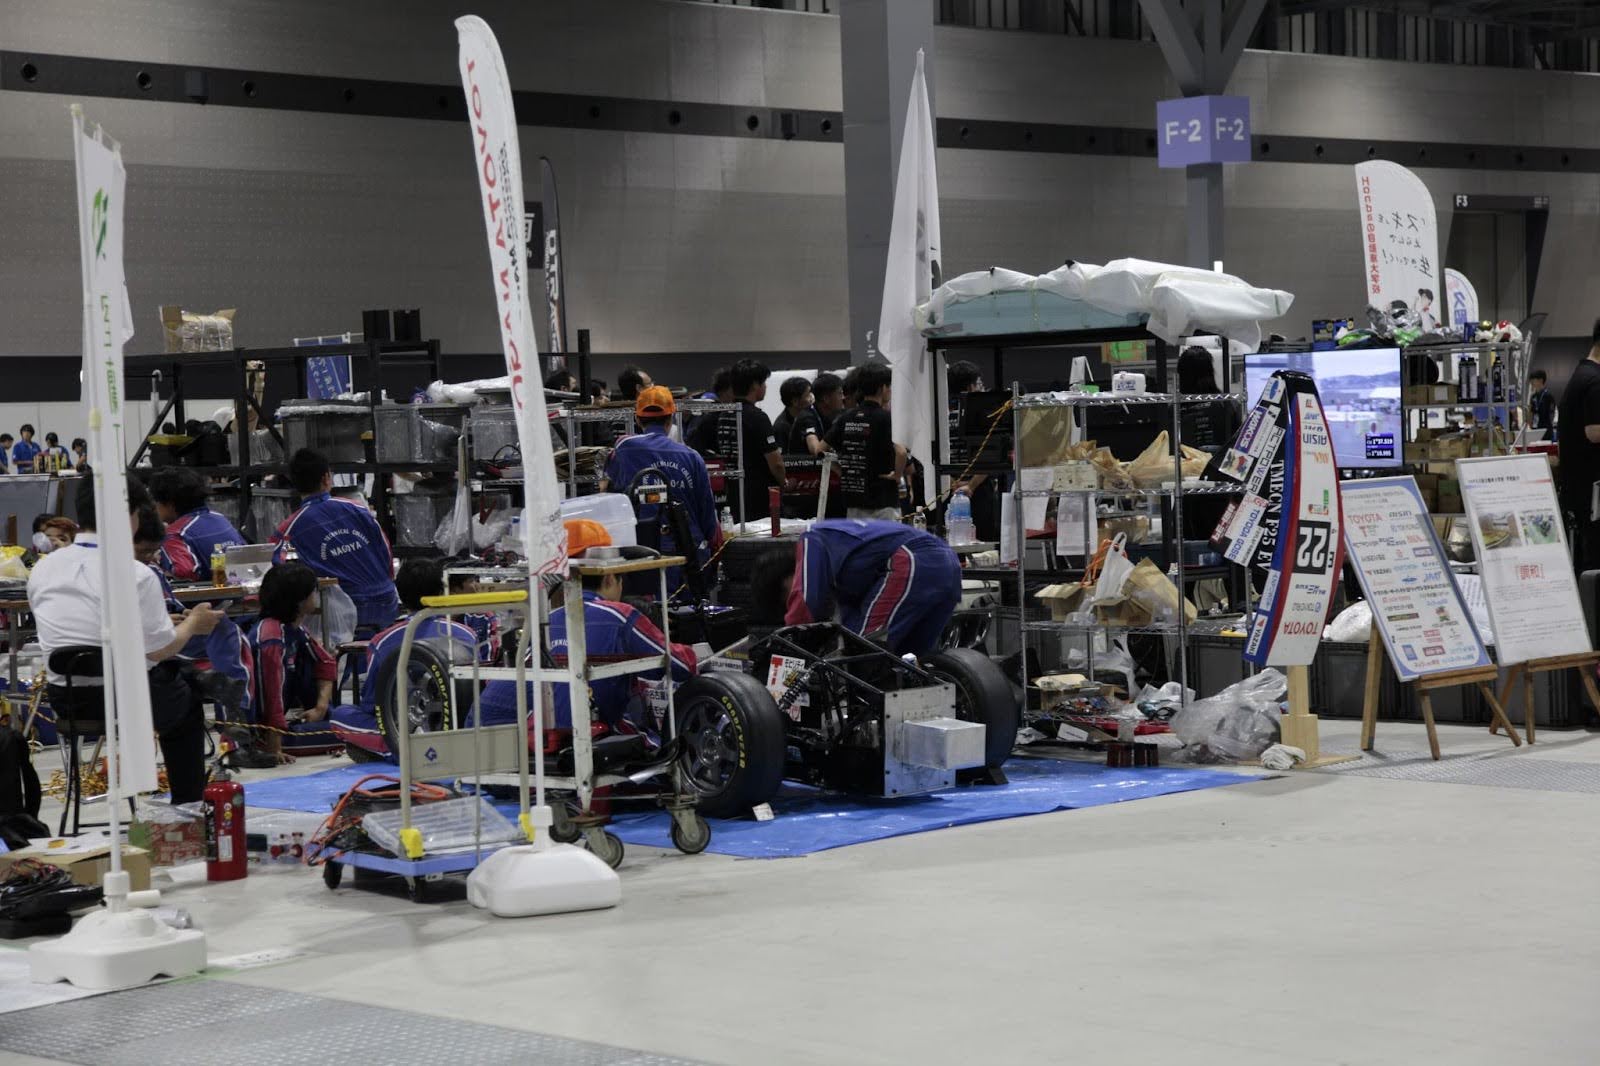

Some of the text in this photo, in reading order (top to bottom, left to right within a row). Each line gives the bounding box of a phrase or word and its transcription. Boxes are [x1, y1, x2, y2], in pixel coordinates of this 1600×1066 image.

[1166, 119, 1202, 144] F-2
[1215, 117, 1245, 140] F-2
[1456, 195, 1468, 207] F3
[1302, 433, 1328, 445] AISIN
[1268, 460, 1285, 513] TMECN
[1347, 513, 1383, 524] TOYOTA
[1262, 518, 1281, 547] F25
[330, 541, 362, 557] NAGOYA
[1296, 526, 1328, 568] 22
[1256, 551, 1274, 573] EV
[1283, 621, 1319, 635] TOYOTA
[722, 695, 746, 769] GOODYEAR
